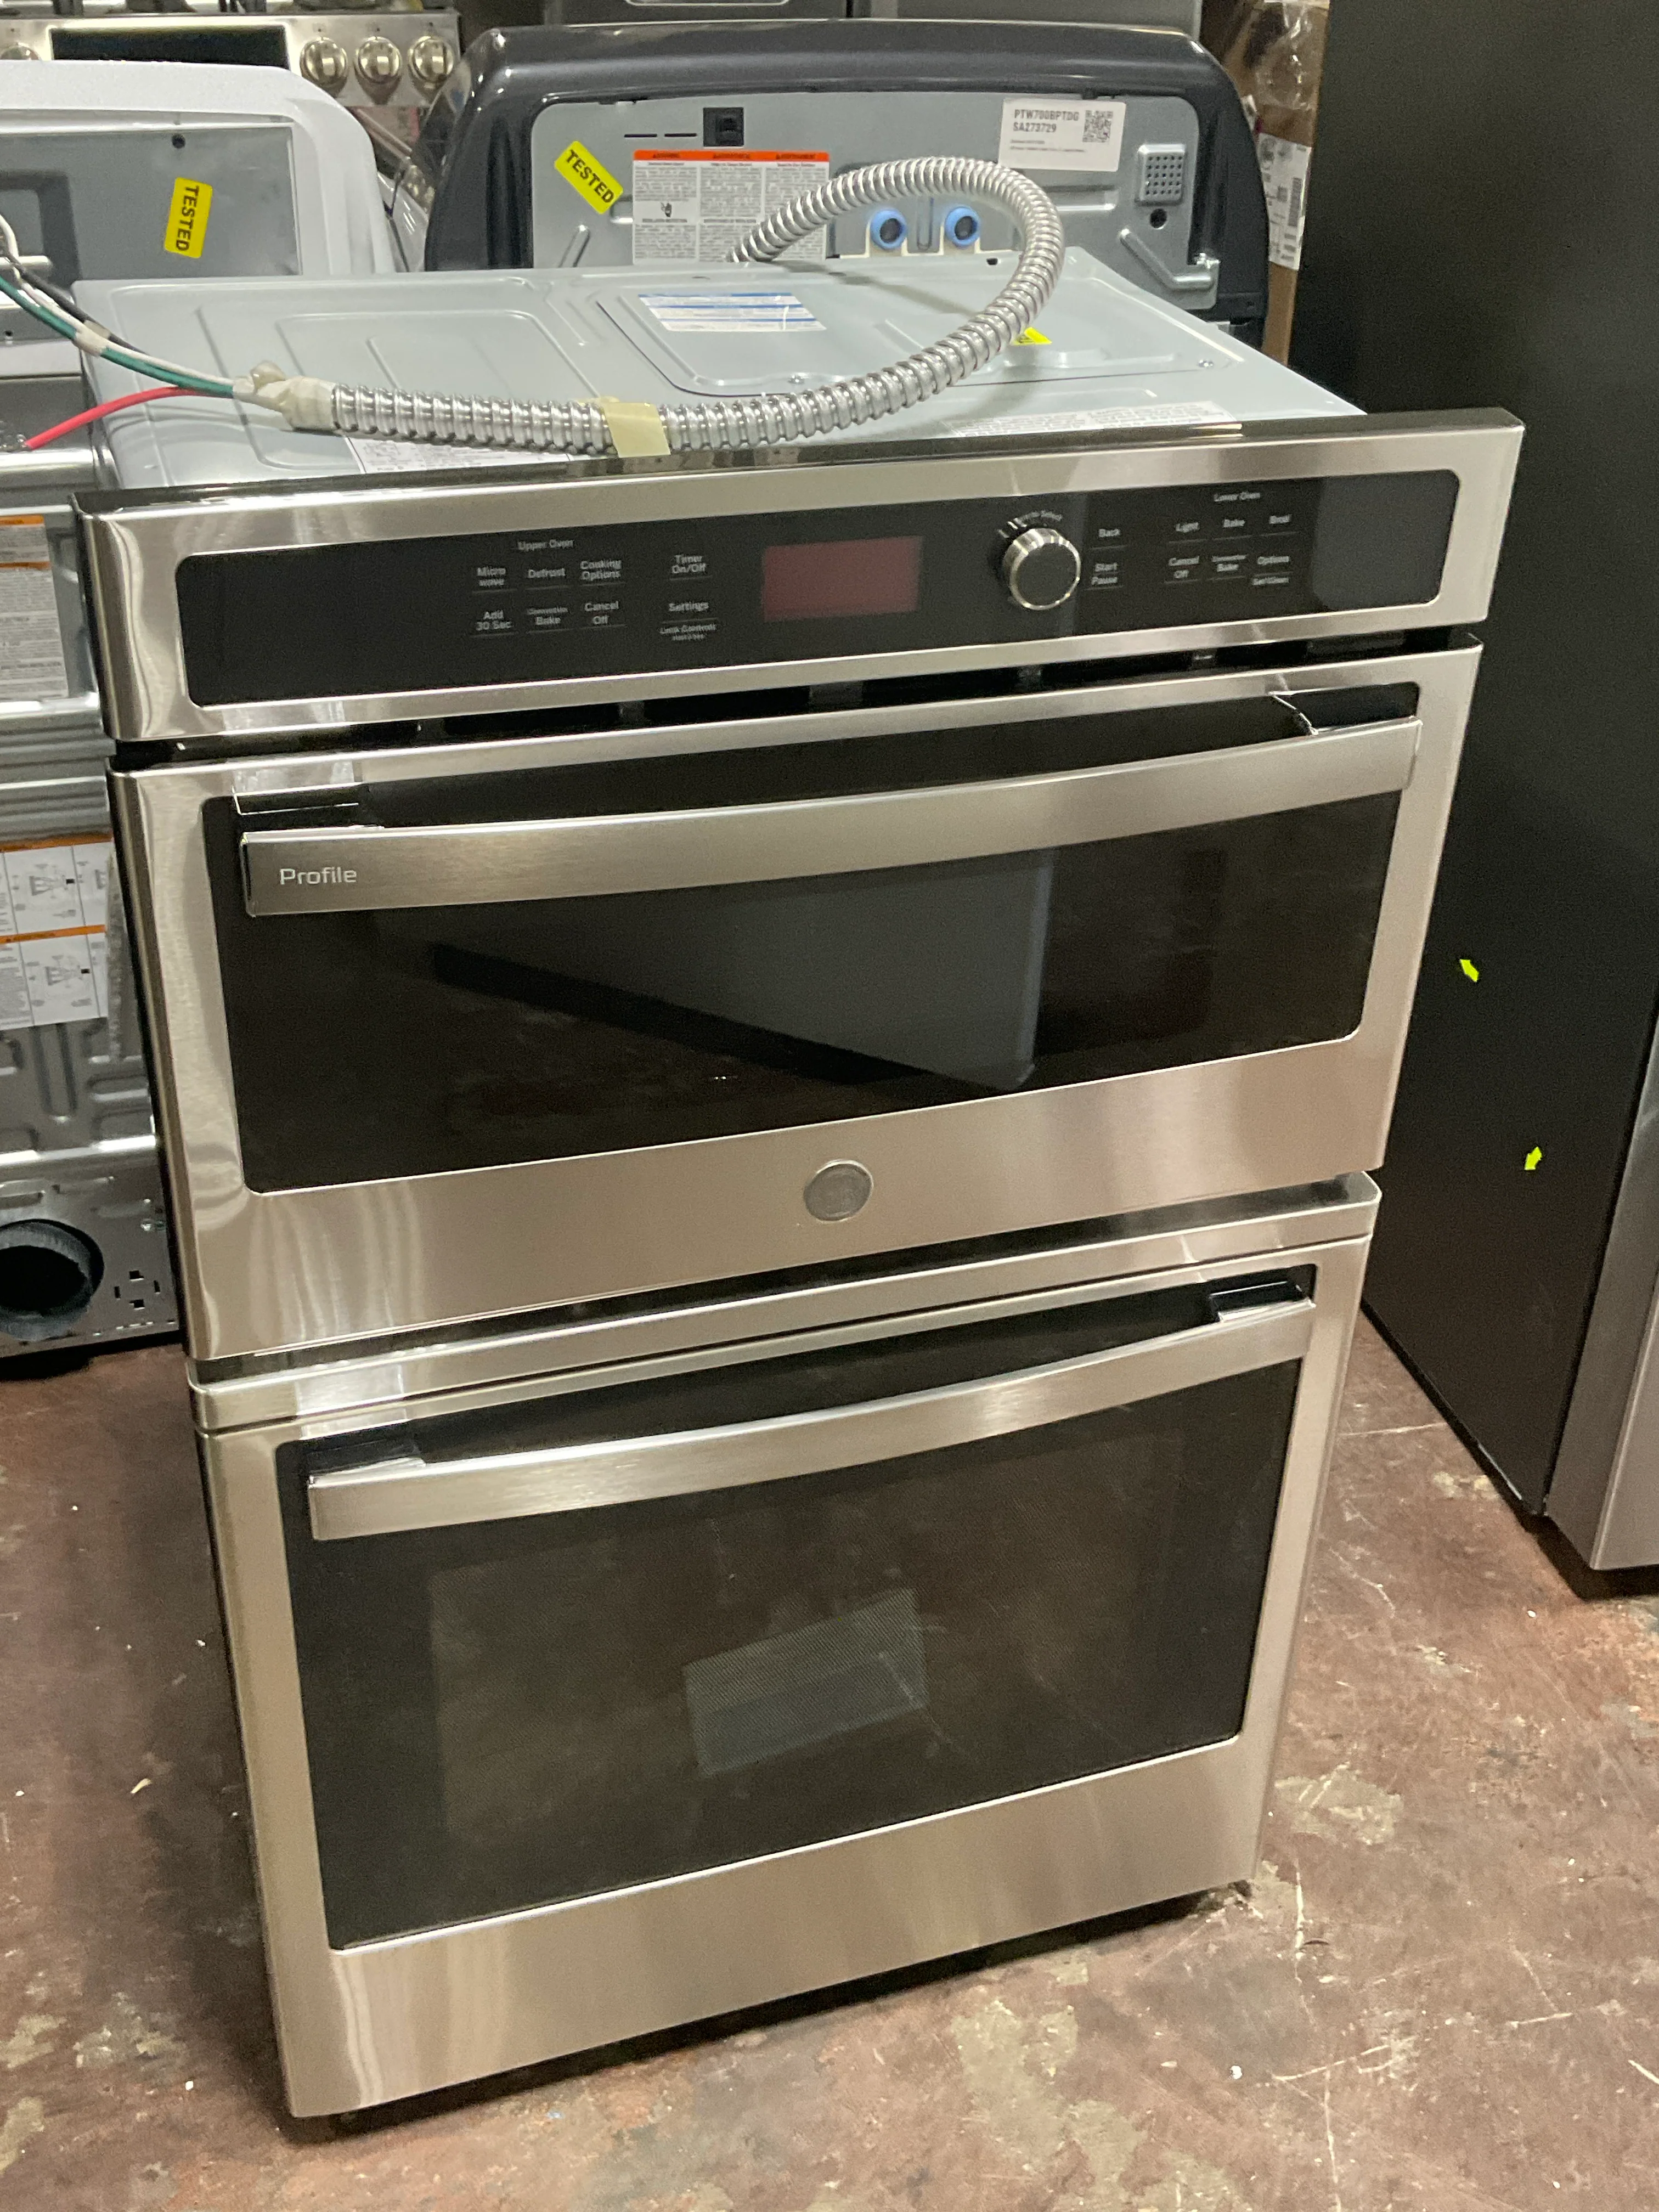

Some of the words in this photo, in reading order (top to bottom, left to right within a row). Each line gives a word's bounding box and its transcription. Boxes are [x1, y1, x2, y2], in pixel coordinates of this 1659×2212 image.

[566, 149, 614, 203] TESTED
[176, 185, 200, 251] TESTED
[517, 540, 548, 551] Upper
[549, 539, 573, 548] Oven
[675, 554, 702, 564] Timer
[580, 560, 622, 570] Cooking
[672, 563, 707, 574] On/Off
[477, 566, 506, 577] Micro
[528, 568, 566, 578] Defrost
[581, 571, 621, 581] Options
[584, 601, 619, 611] Cancel
[668, 602, 709, 612] Settings
[483, 610, 504, 620] Add
[592, 615, 610, 624] Off
[476, 622, 490, 631] 30
[492, 620, 512, 630] Sec
[536, 616, 561, 625] Bake
[280, 866, 357, 885] Profile
